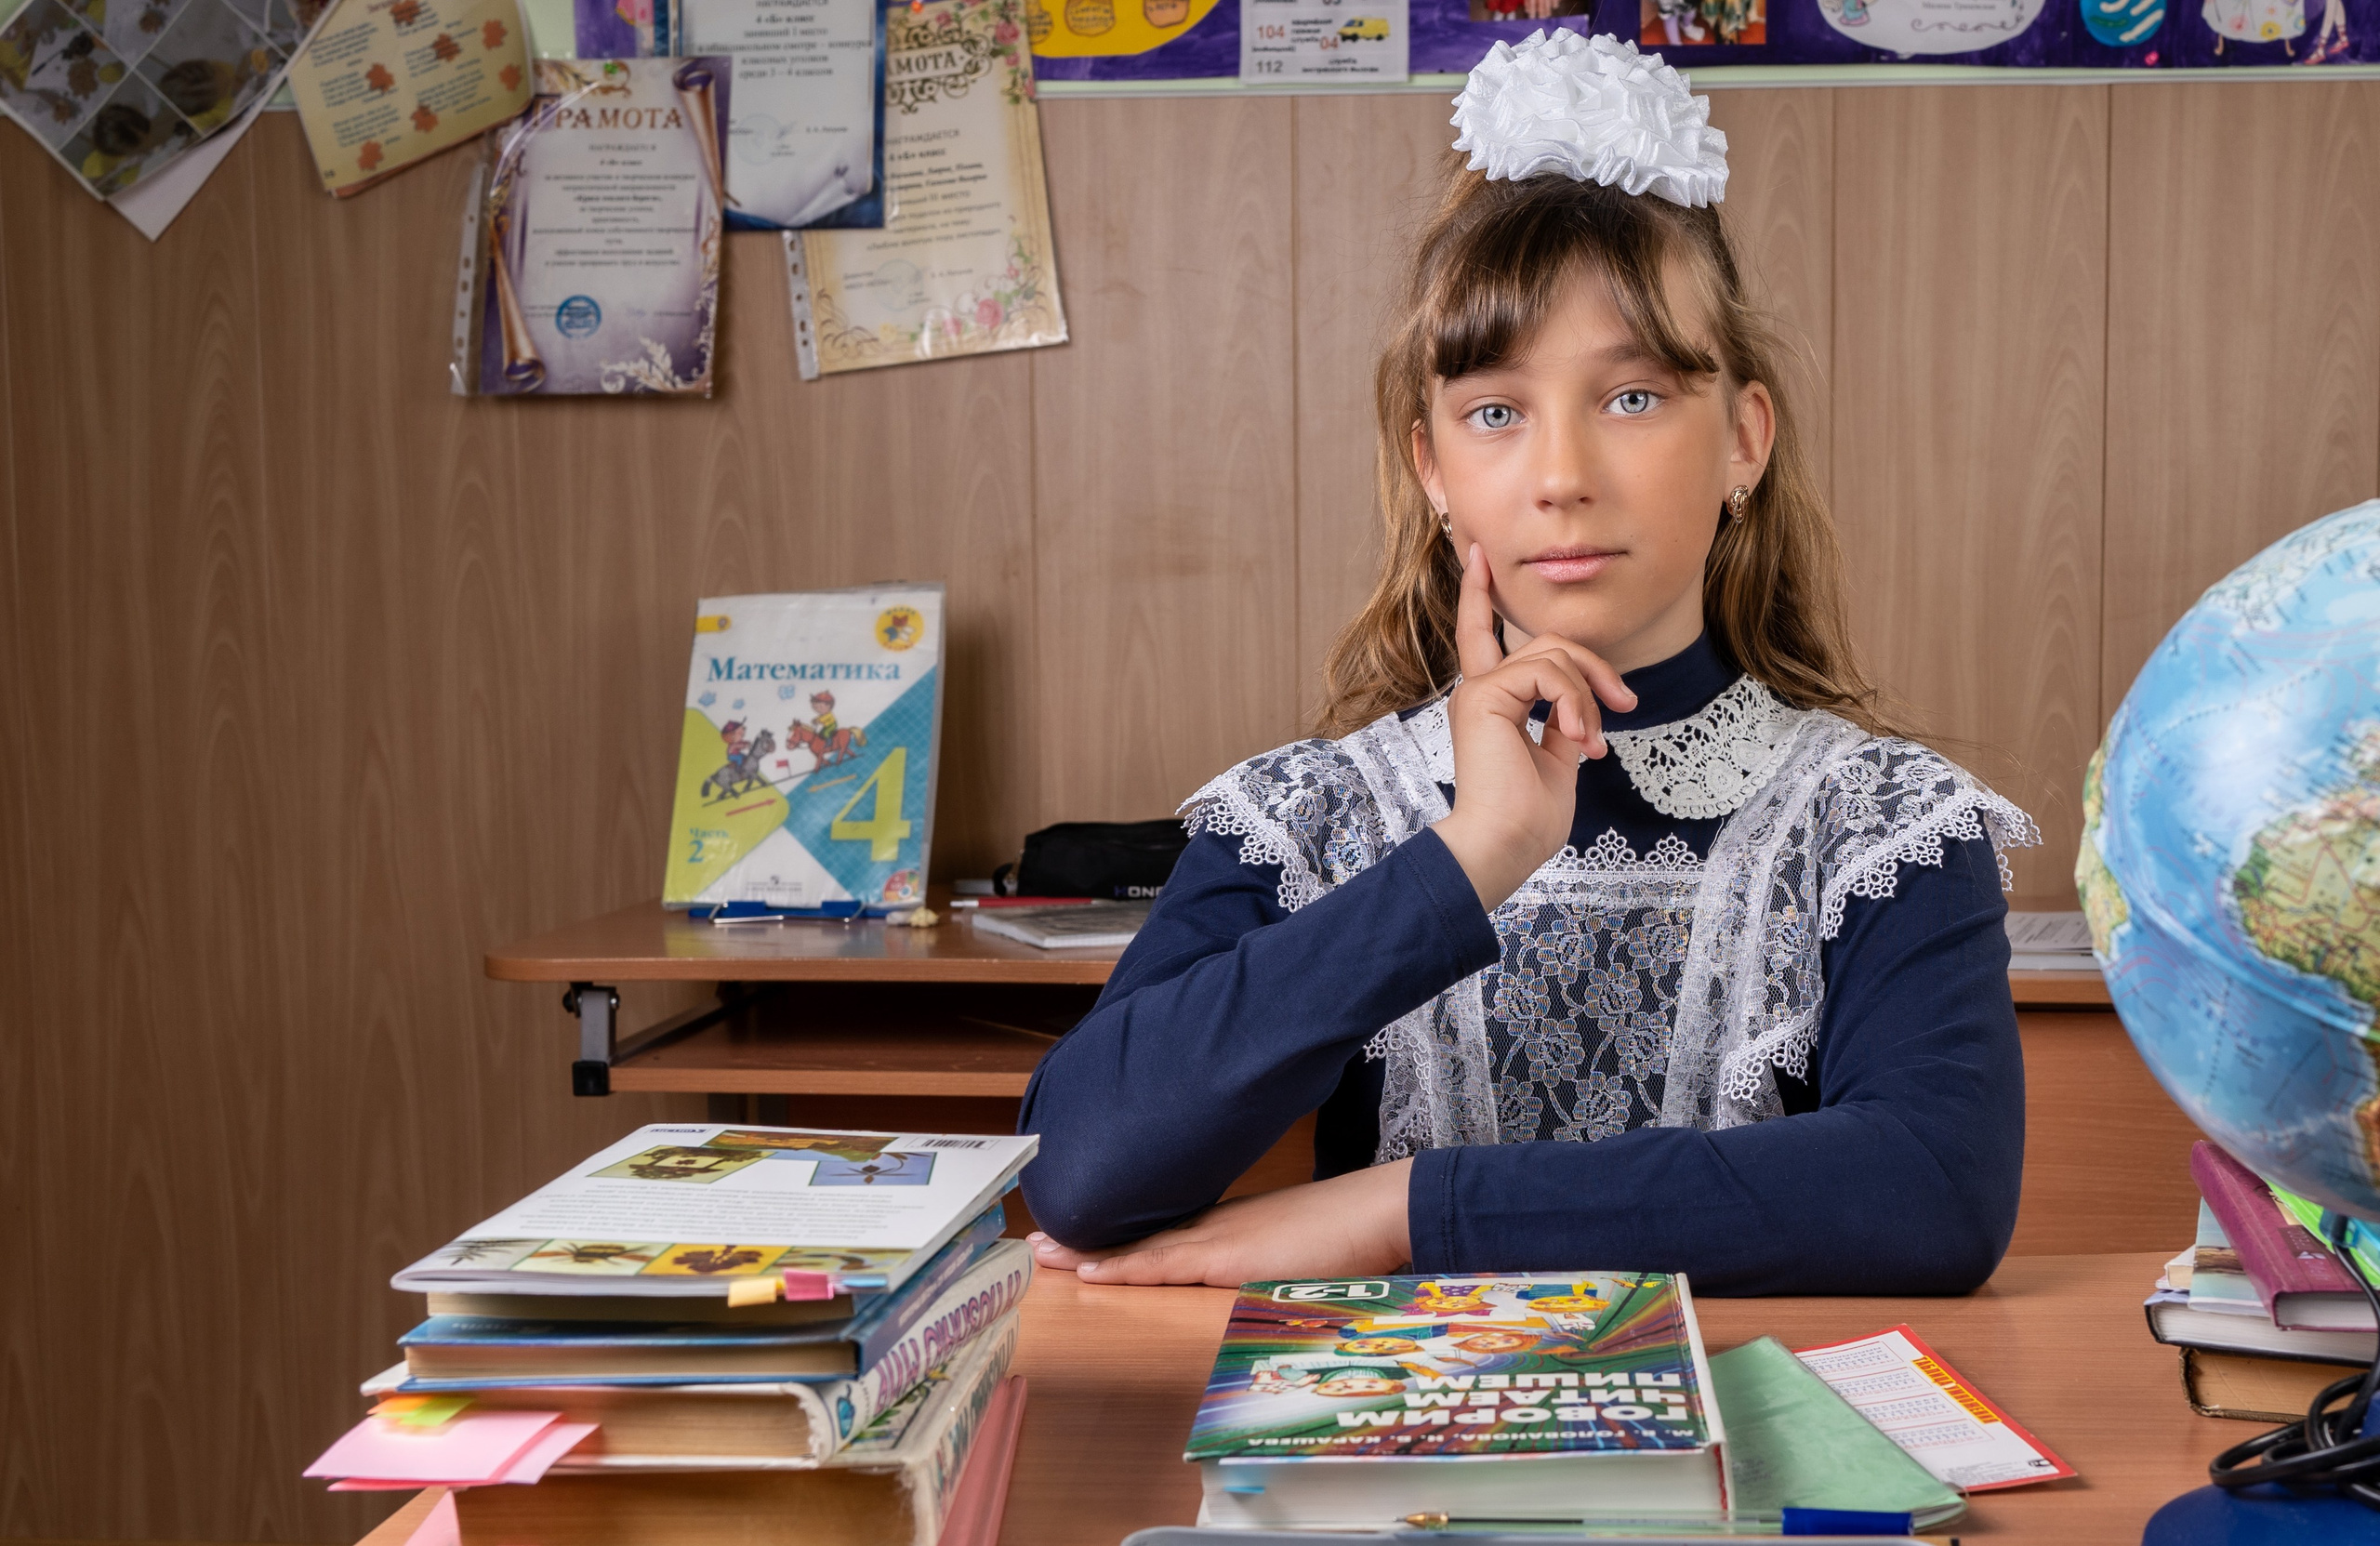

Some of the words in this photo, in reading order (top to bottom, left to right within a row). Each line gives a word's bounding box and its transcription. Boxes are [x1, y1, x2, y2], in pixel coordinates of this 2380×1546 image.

[1257, 25, 1285, 39] 104
[1320, 36, 1339, 50] 04
[887, 50, 958, 74] МОТА
[1257, 60, 1283, 73] 112
[533, 97, 683, 130] ГРАМОТА
[706, 655, 902, 681] Математика
[830, 747, 911, 862] 4
[689, 826, 728, 839] Часть
[687, 839, 705, 863] 2
[1289, 1283, 1373, 1300] 1-2
[1912, 1355, 1954, 1387] ТАБЛИЦА
[1414, 1372, 1682, 1389] ПИШЕМ
[1403, 1389, 1686, 1407] ЧИТАЕМ
[1336, 1406, 1688, 1427] ГОВОРИМ
[1247, 1435, 1382, 1447] КАРАШЕВА
[1422, 1433, 1444, 1443] Н.
[1454, 1430, 1625, 1443] ГОЛОВАНОВА,
[1664, 1429, 1694, 1439] М.
